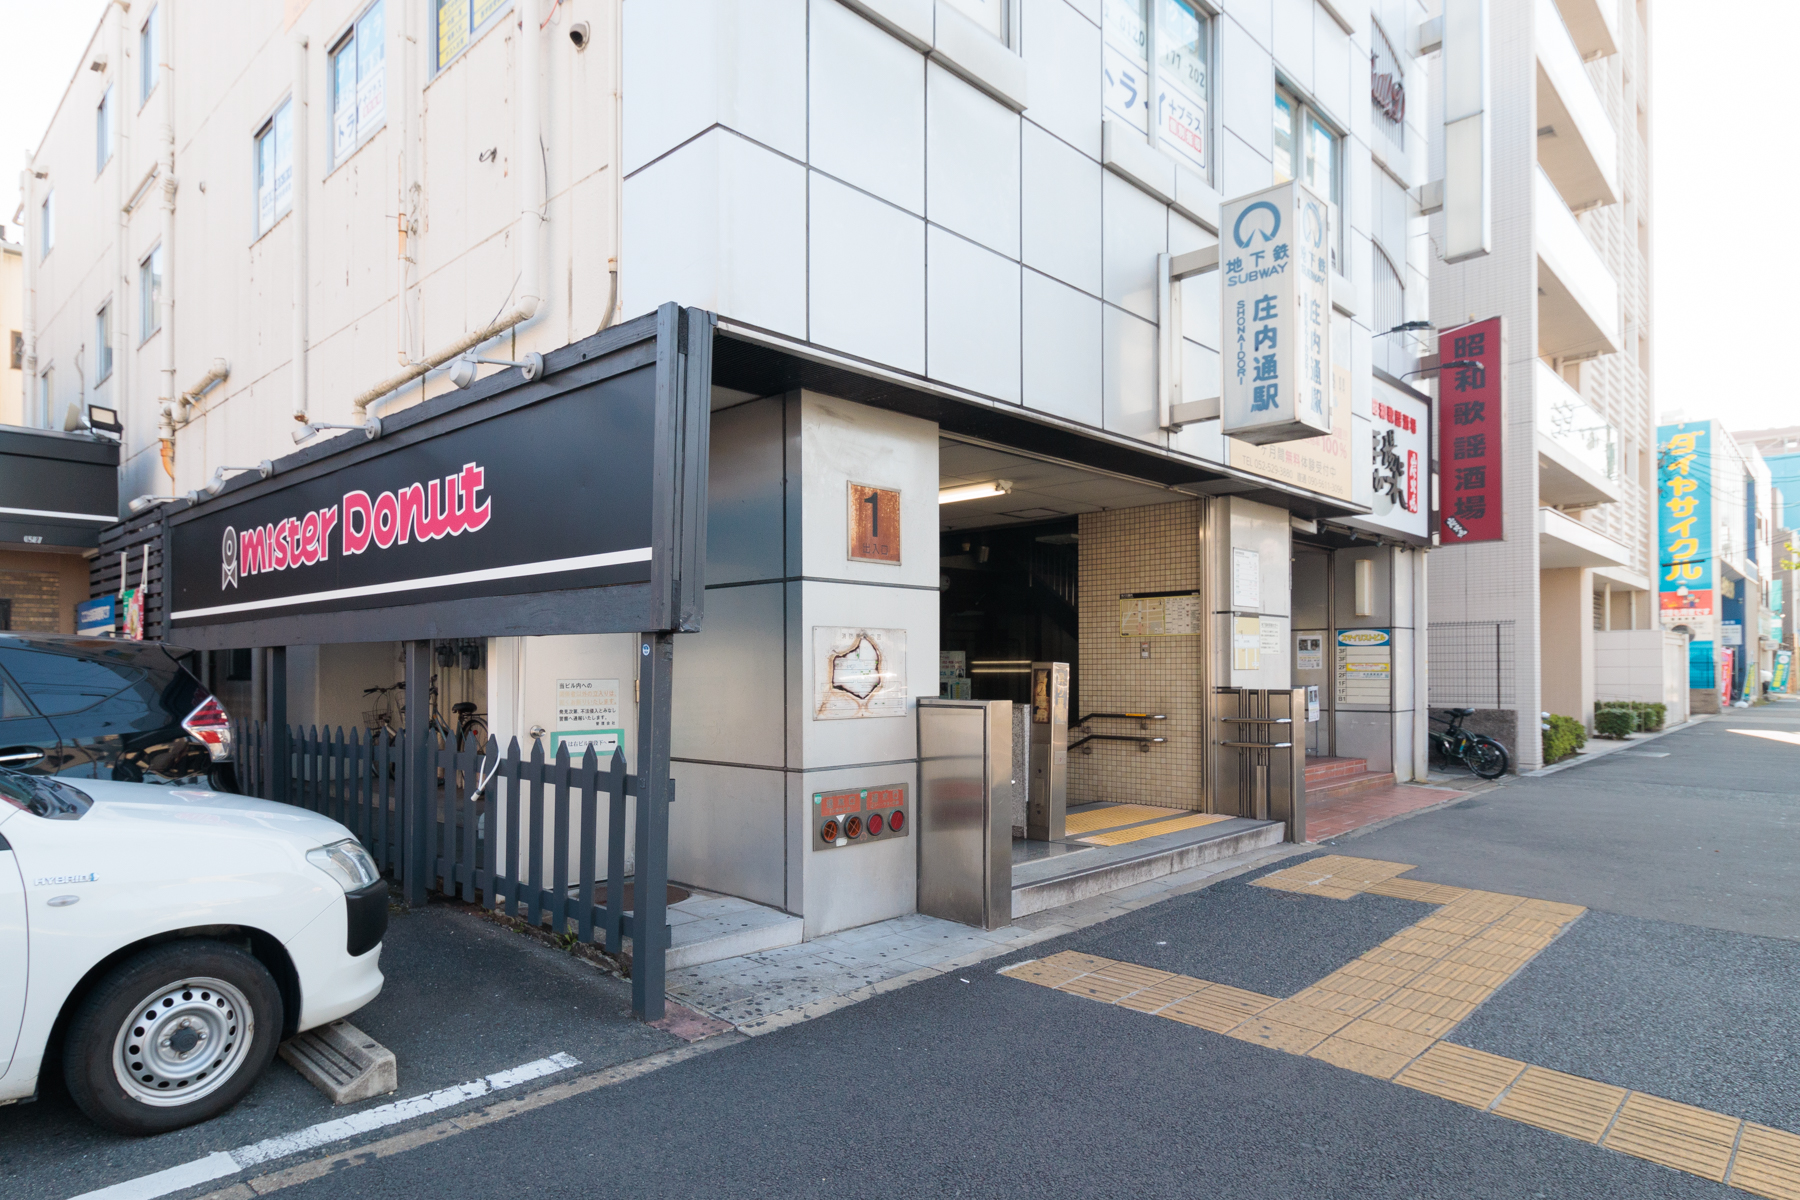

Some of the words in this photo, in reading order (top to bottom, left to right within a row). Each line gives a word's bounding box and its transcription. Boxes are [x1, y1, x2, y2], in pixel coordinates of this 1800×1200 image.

[1226, 242, 1290, 275] 地下鉄
[1228, 262, 1289, 288] SUBWAY
[1236, 300, 1246, 386] SHONAIDORI
[1250, 293, 1280, 413] 庄内通駅
[1453, 332, 1487, 520] 昭和歌謡酒場
[1242, 455, 1253, 467] TEL
[240, 504, 338, 577] mister
[342, 461, 492, 556] Donut
[863, 491, 878, 538] 1
[1665, 430, 1705, 582] ダイヤサイクル
[862, 542, 889, 556] 出入口
[559, 682, 593, 690] 当ビル内への
[34, 874, 90, 887] HYBRID
